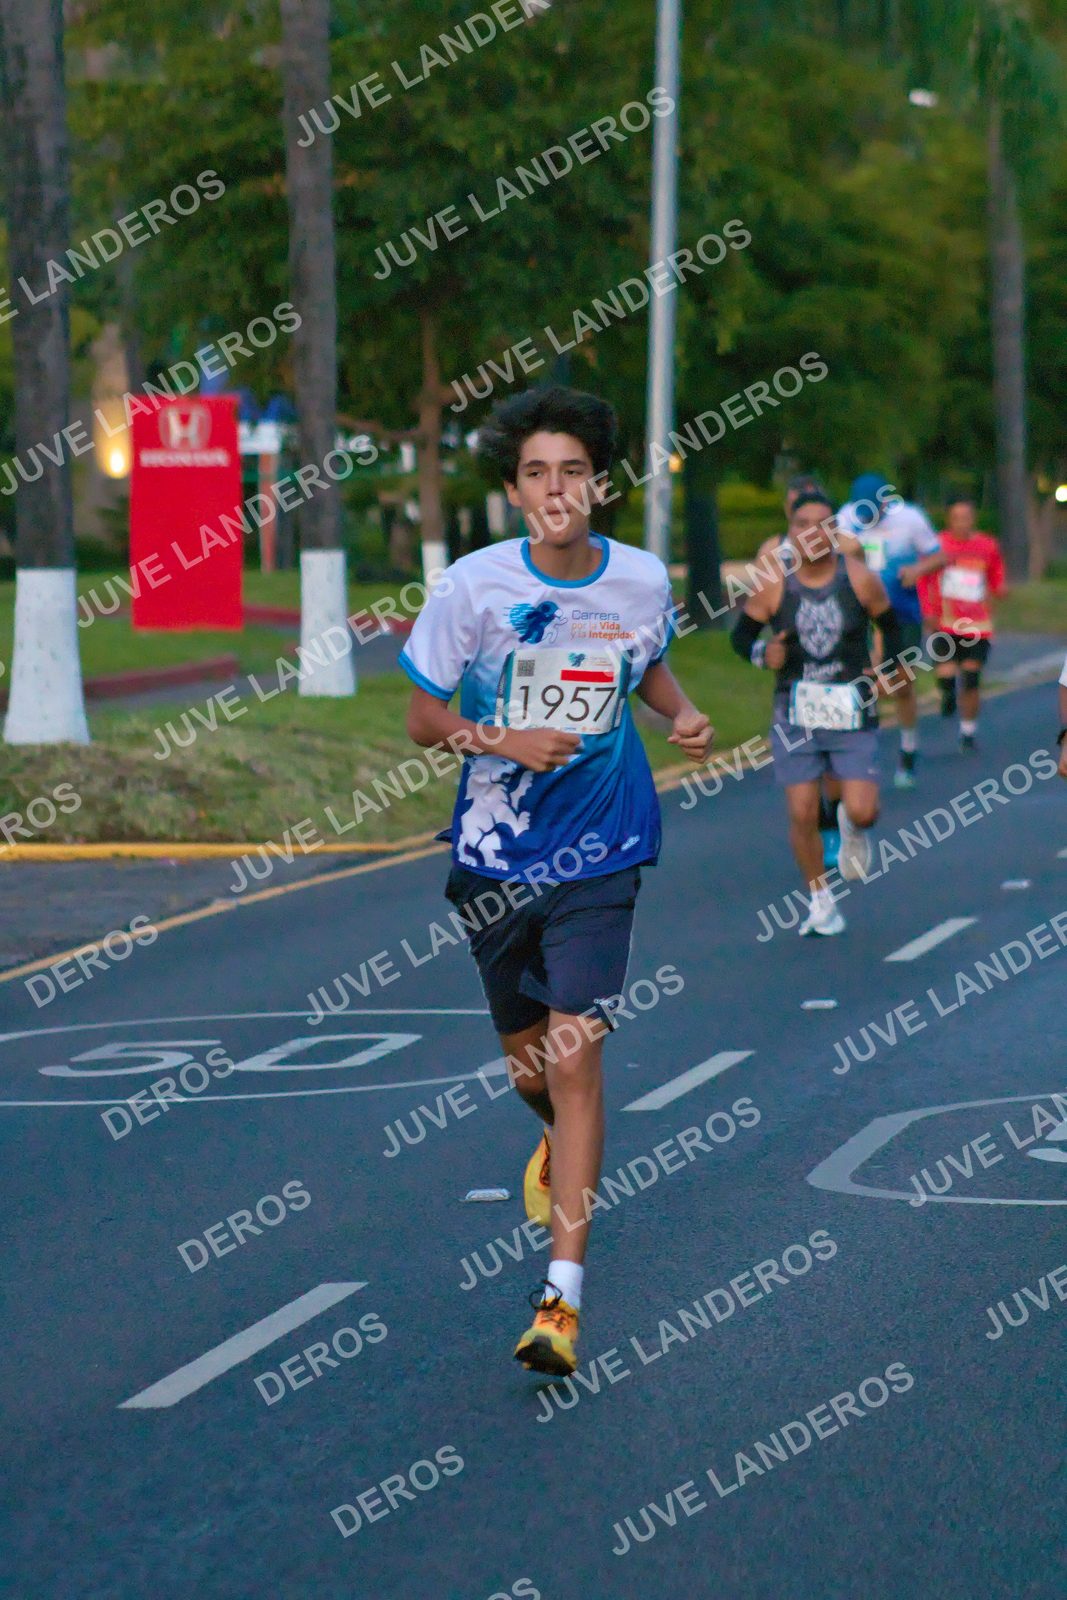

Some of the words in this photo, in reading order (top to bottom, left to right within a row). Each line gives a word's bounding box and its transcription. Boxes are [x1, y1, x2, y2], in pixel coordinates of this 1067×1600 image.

[571, 610, 620, 621] Carrera
[600, 621, 620, 631] Vida
[589, 630, 635, 642] Integridad
[519, 684, 617, 723] 1957
[38, 1032, 423, 1077] 50
